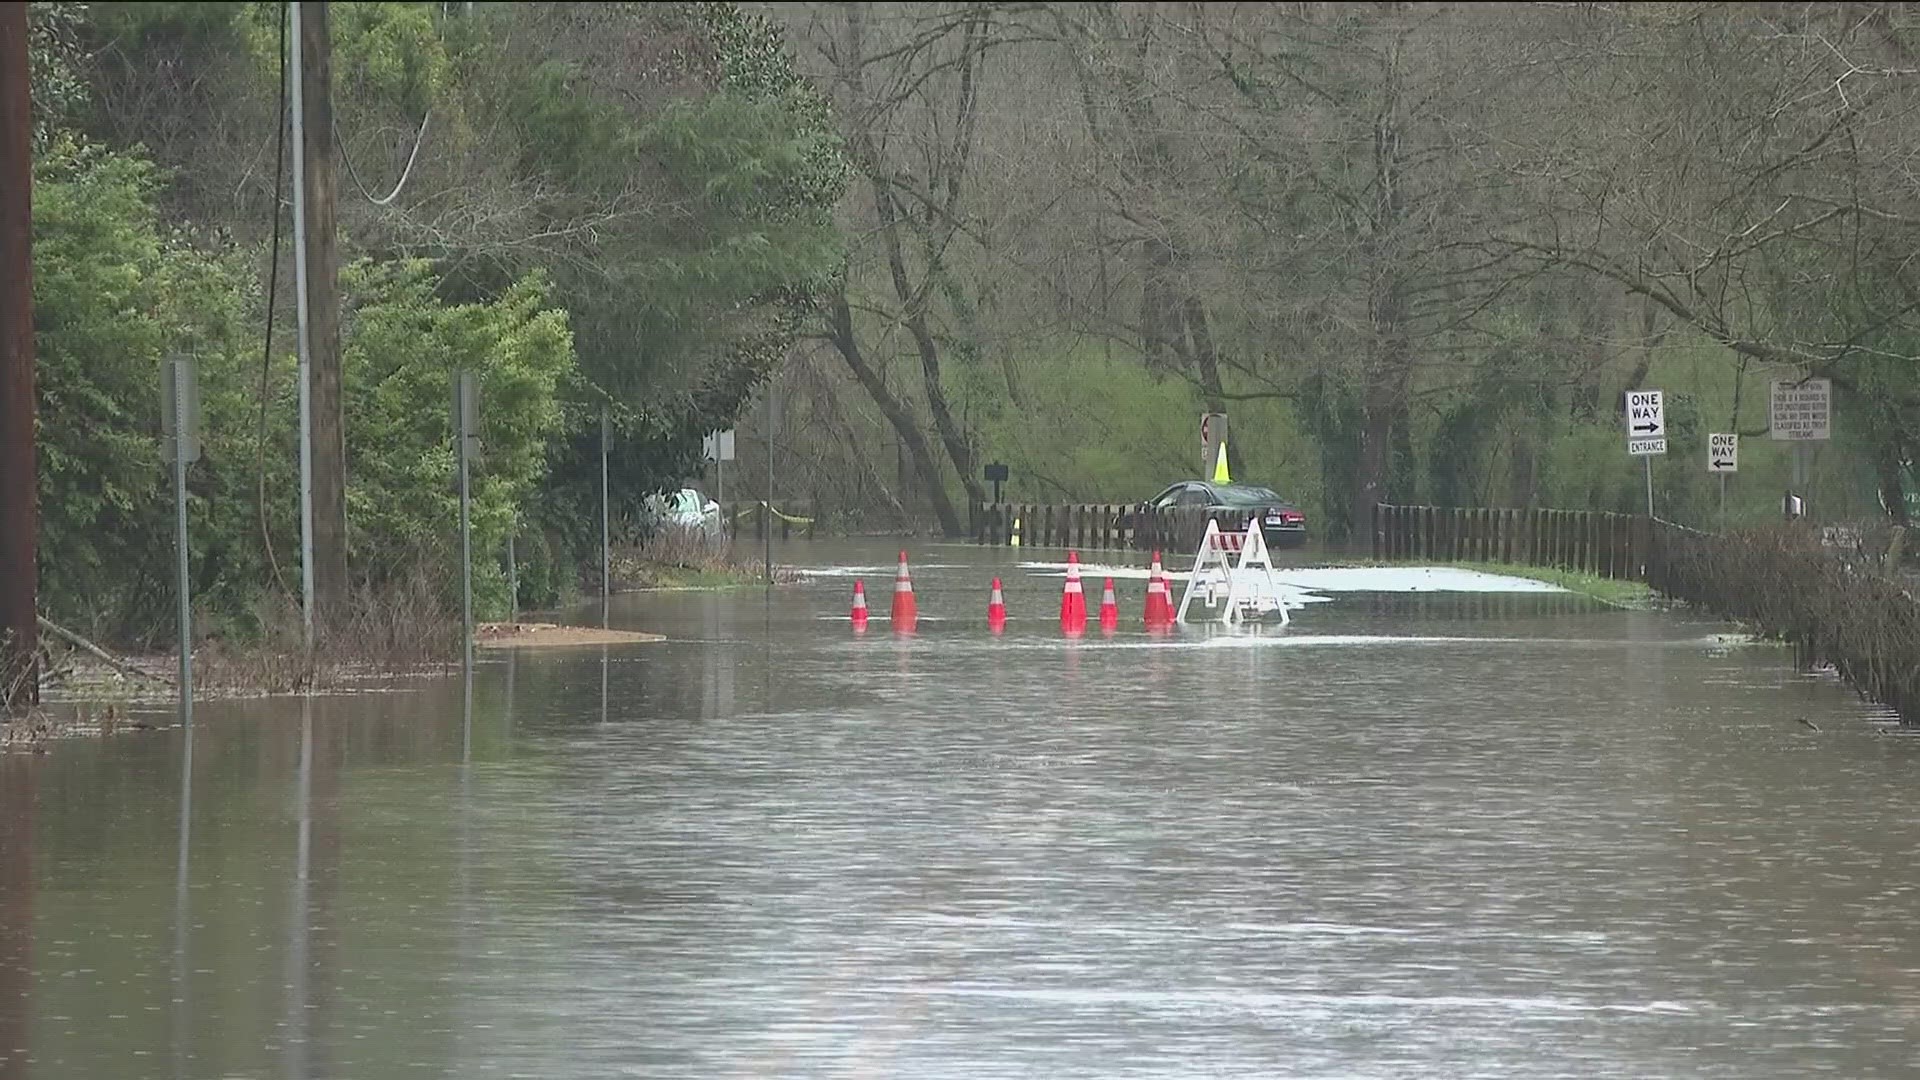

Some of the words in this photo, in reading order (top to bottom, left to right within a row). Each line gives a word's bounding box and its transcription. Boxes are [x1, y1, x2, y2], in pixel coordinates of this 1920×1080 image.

[1632, 393, 1658, 406] ONE
[1632, 406, 1659, 419] WAY
[1712, 435, 1735, 446] ONE
[1631, 441, 1664, 453] ENTRANCE
[1712, 446, 1735, 457] WAY
